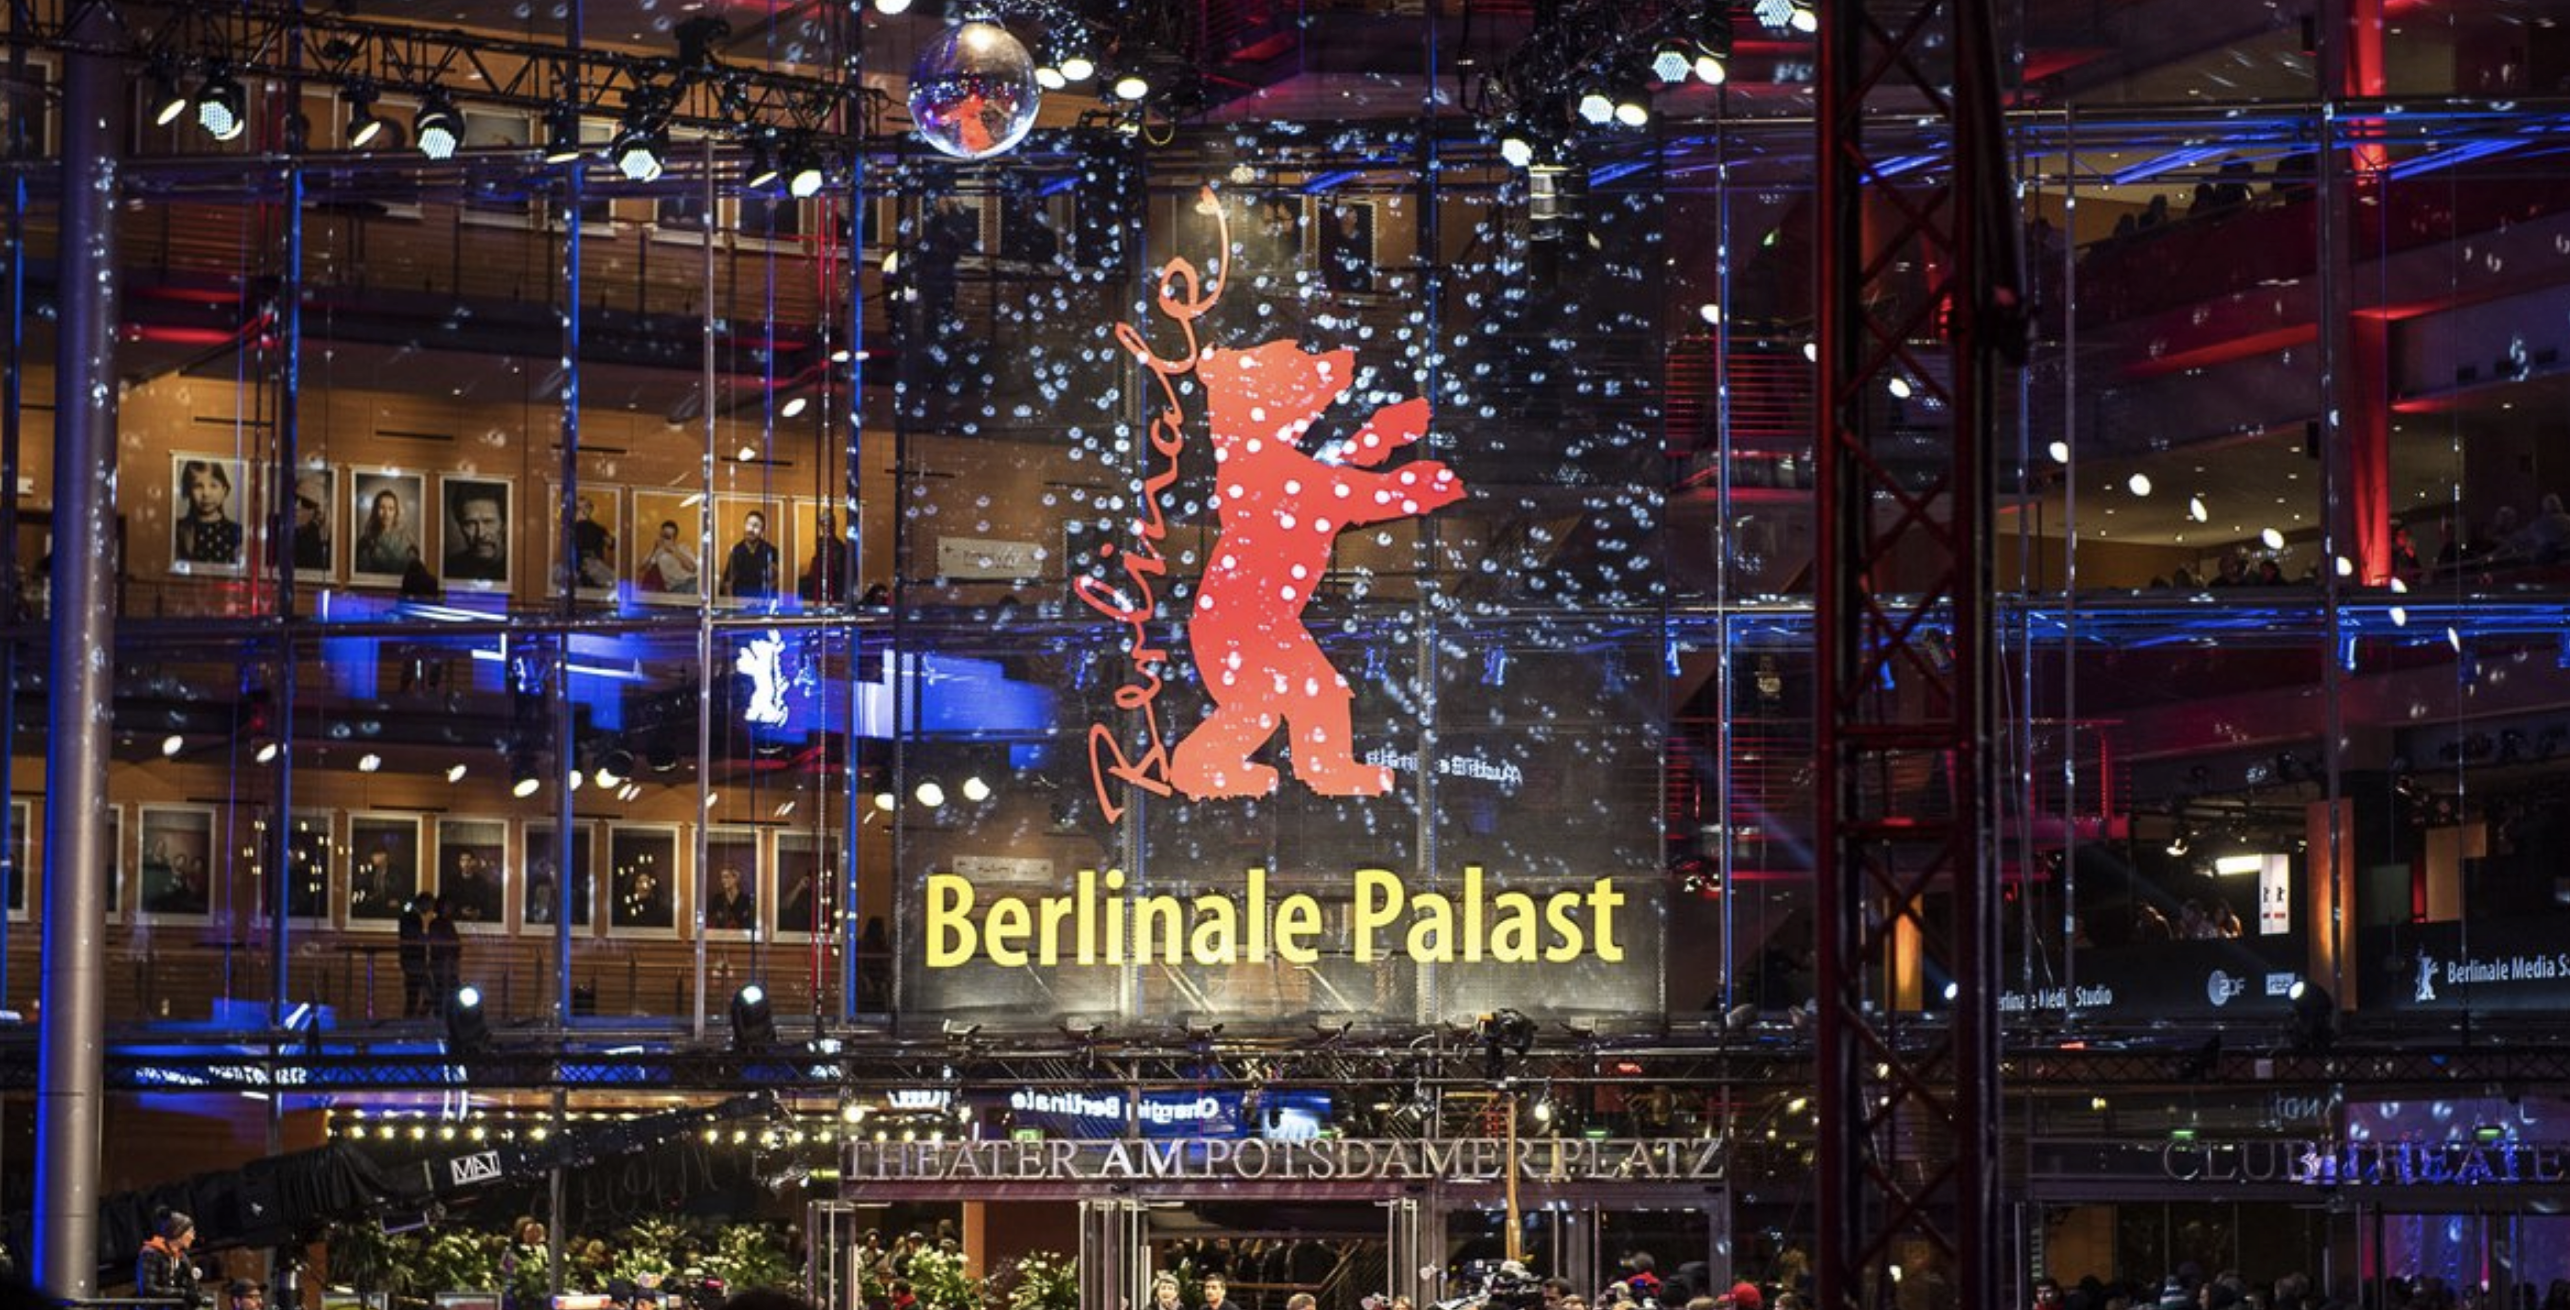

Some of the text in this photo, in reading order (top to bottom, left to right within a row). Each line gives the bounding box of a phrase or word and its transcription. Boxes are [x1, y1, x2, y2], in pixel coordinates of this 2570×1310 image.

[1074, 184, 1229, 824] Berlinale
[926, 866, 1625, 967] Berlinale Palast
[2447, 952, 2570, 984] Berlinale Media S
[2038, 986, 2067, 1008] Medi
[2074, 983, 2113, 1007] Studio
[843, 1135, 1724, 1180] THEATER AM POTSDAMER PLATZ
[2163, 1139, 2317, 1182] CLUB
